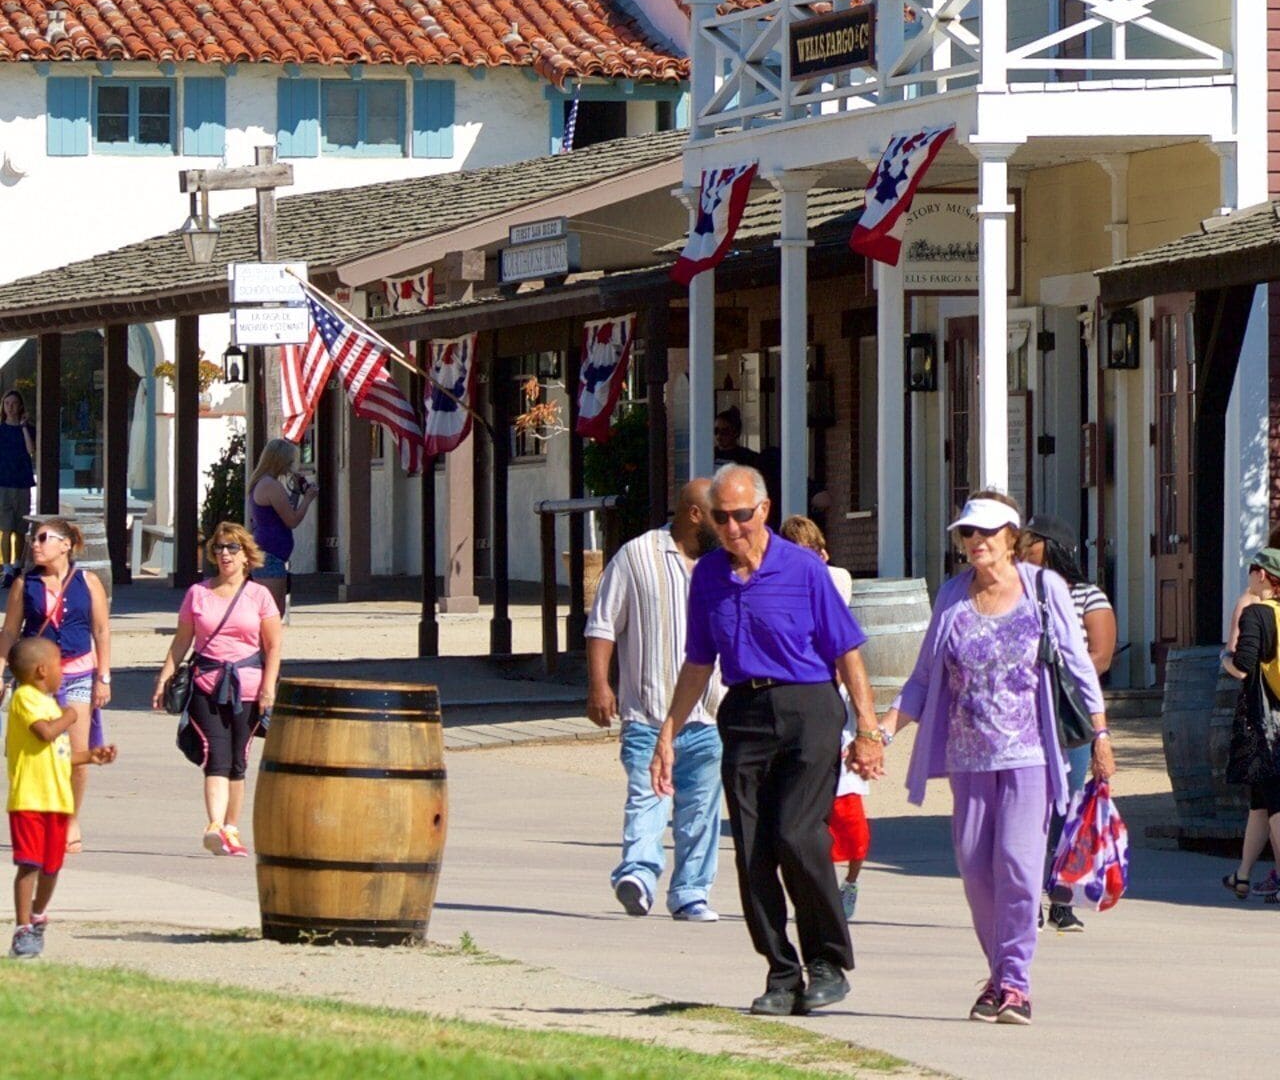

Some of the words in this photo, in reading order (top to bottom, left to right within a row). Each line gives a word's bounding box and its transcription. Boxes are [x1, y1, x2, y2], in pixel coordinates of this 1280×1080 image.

[826, 27, 855, 57] FARGO
[905, 202, 941, 225] STORY
[946, 203, 979, 223] MUSE
[515, 227, 530, 240] FIRST
[531, 225, 541, 237] SAN
[542, 222, 557, 235] DIEGO
[904, 275, 926, 283] ELLS
[930, 275, 961, 283] FARGO
[251, 313, 260, 321] LA
[239, 322, 269, 332] MACHADO
[275, 321, 304, 331] STEWART
